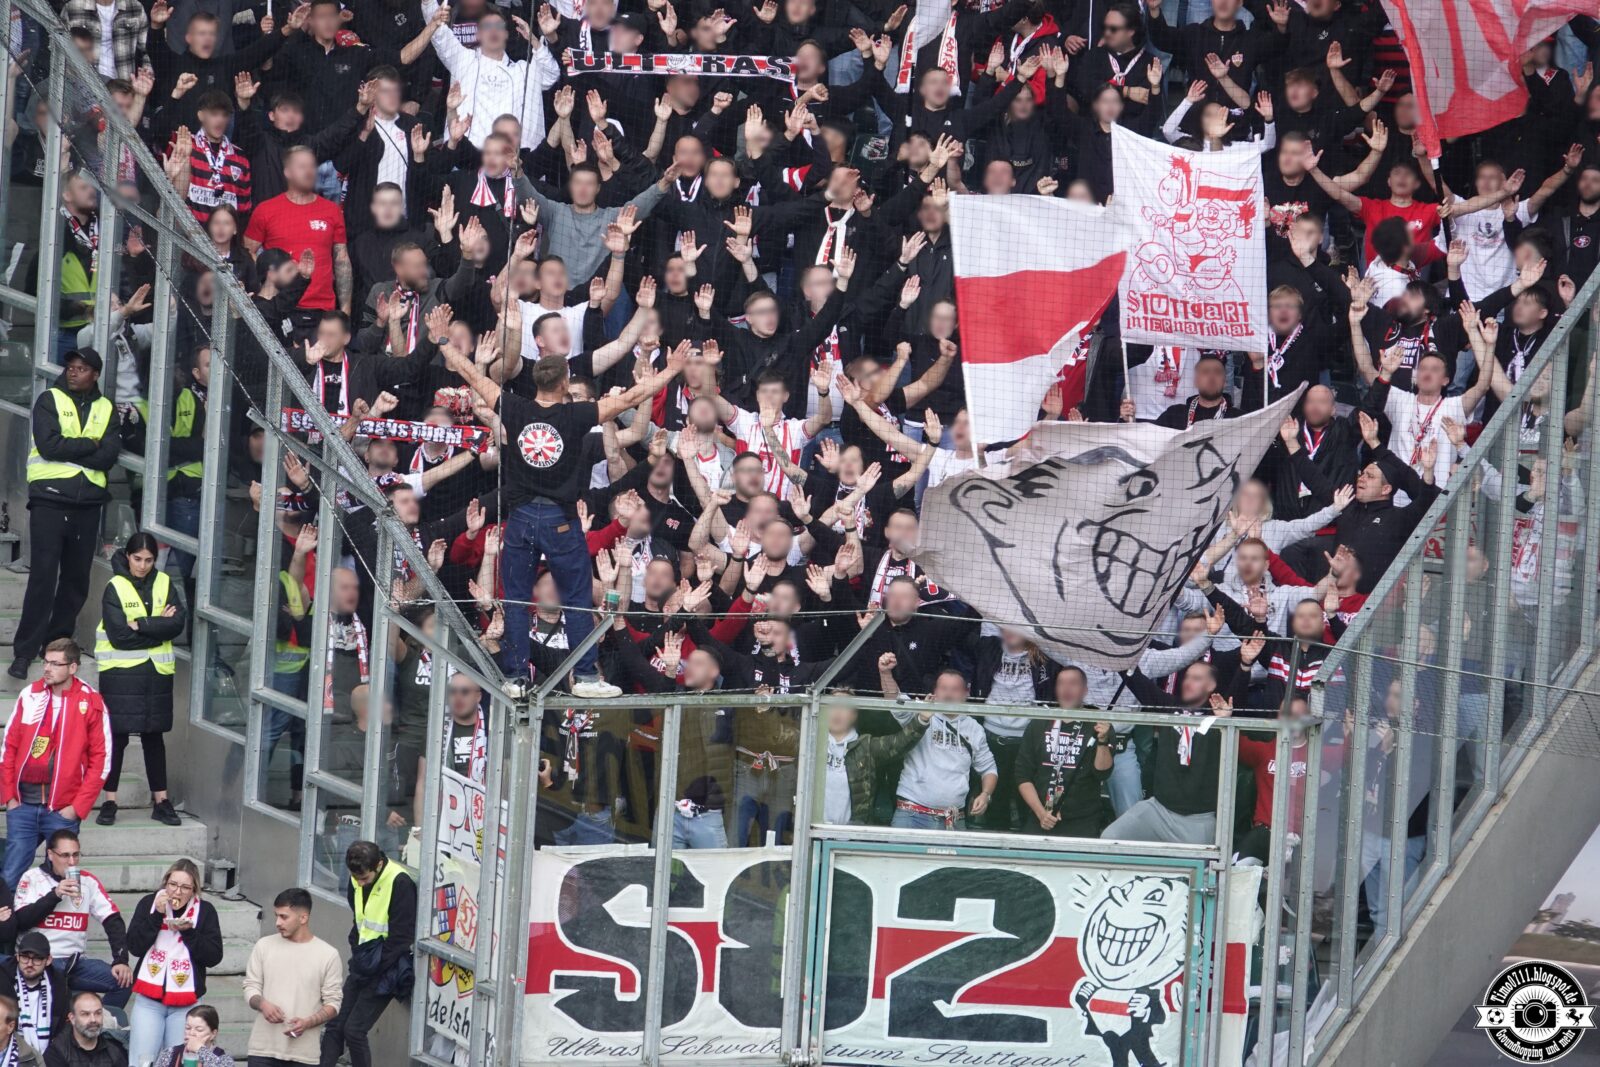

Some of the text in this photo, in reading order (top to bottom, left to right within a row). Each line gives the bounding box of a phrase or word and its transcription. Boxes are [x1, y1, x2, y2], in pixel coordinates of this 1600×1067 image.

[453, 26, 478, 34] SCHWA
[44, 914, 83, 929] EnBW
[429, 993, 471, 1039] delsh
[548, 1036, 643, 1058] Ultras
[914, 1043, 1087, 1067] Stuttgart
